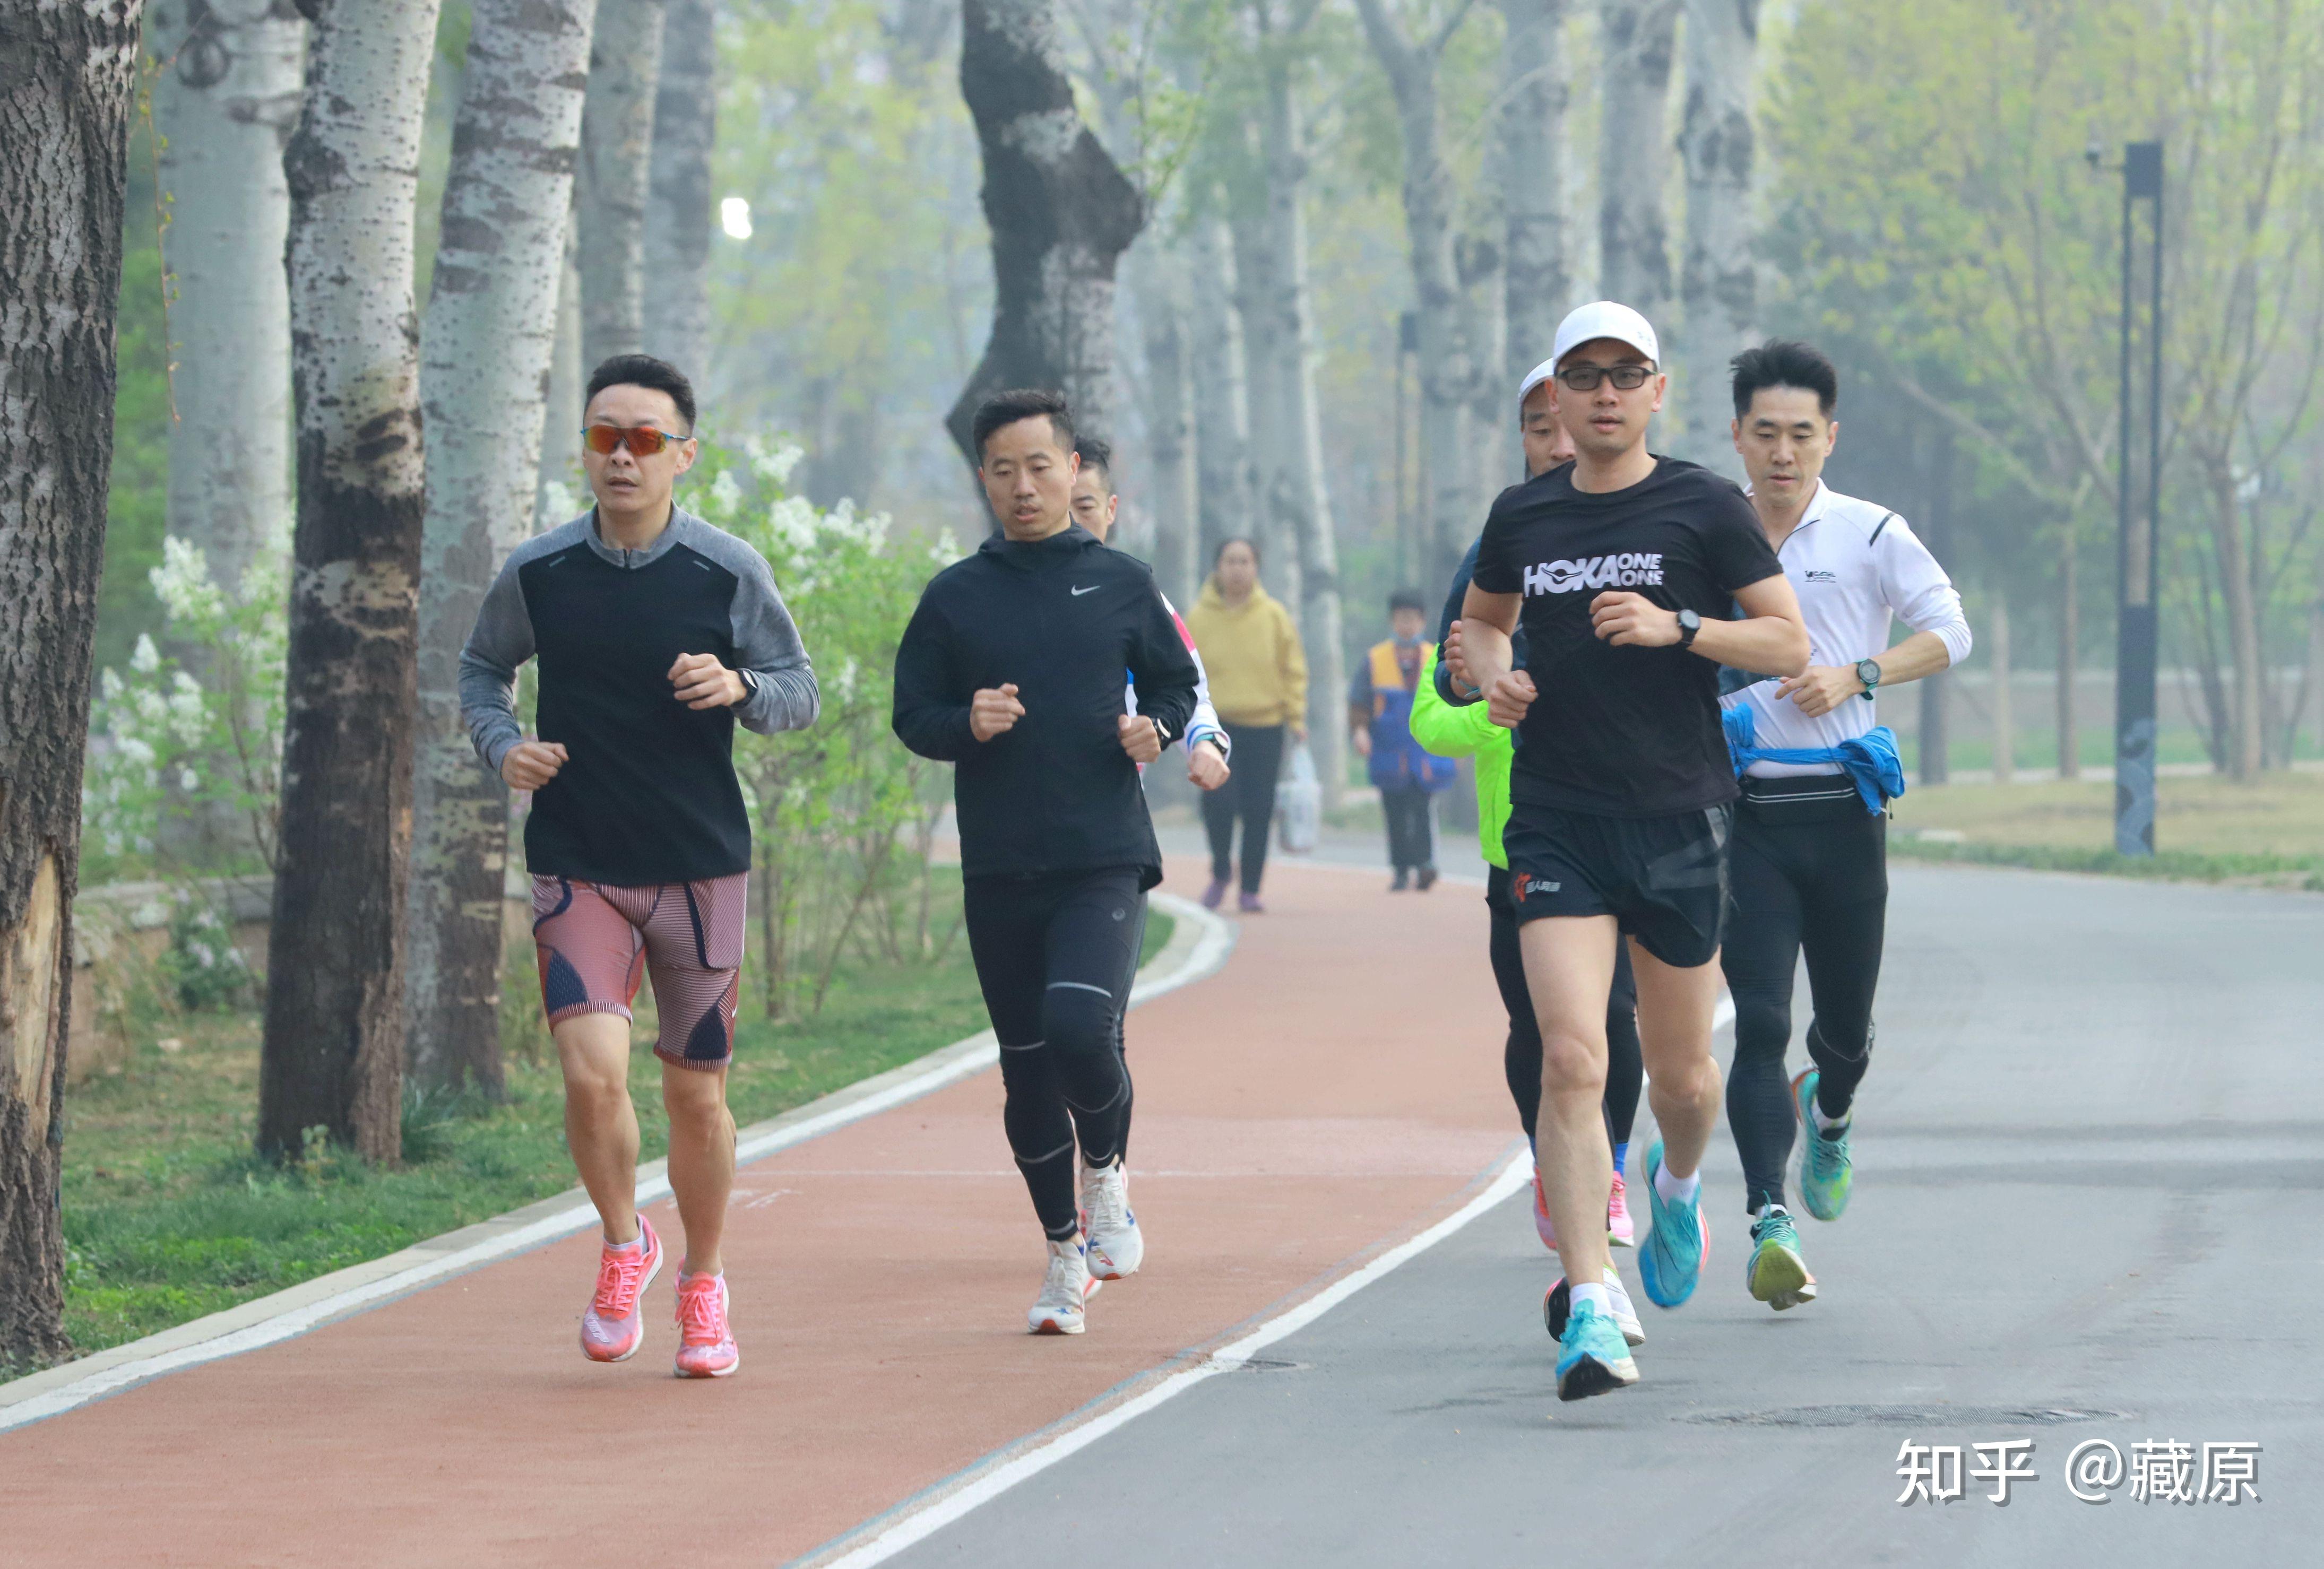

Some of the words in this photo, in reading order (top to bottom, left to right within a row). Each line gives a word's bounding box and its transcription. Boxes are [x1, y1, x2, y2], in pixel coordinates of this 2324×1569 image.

[1618, 553, 1663, 570] ONE
[1524, 554, 1620, 597] HOKA
[1620, 570, 1664, 586] ONE
